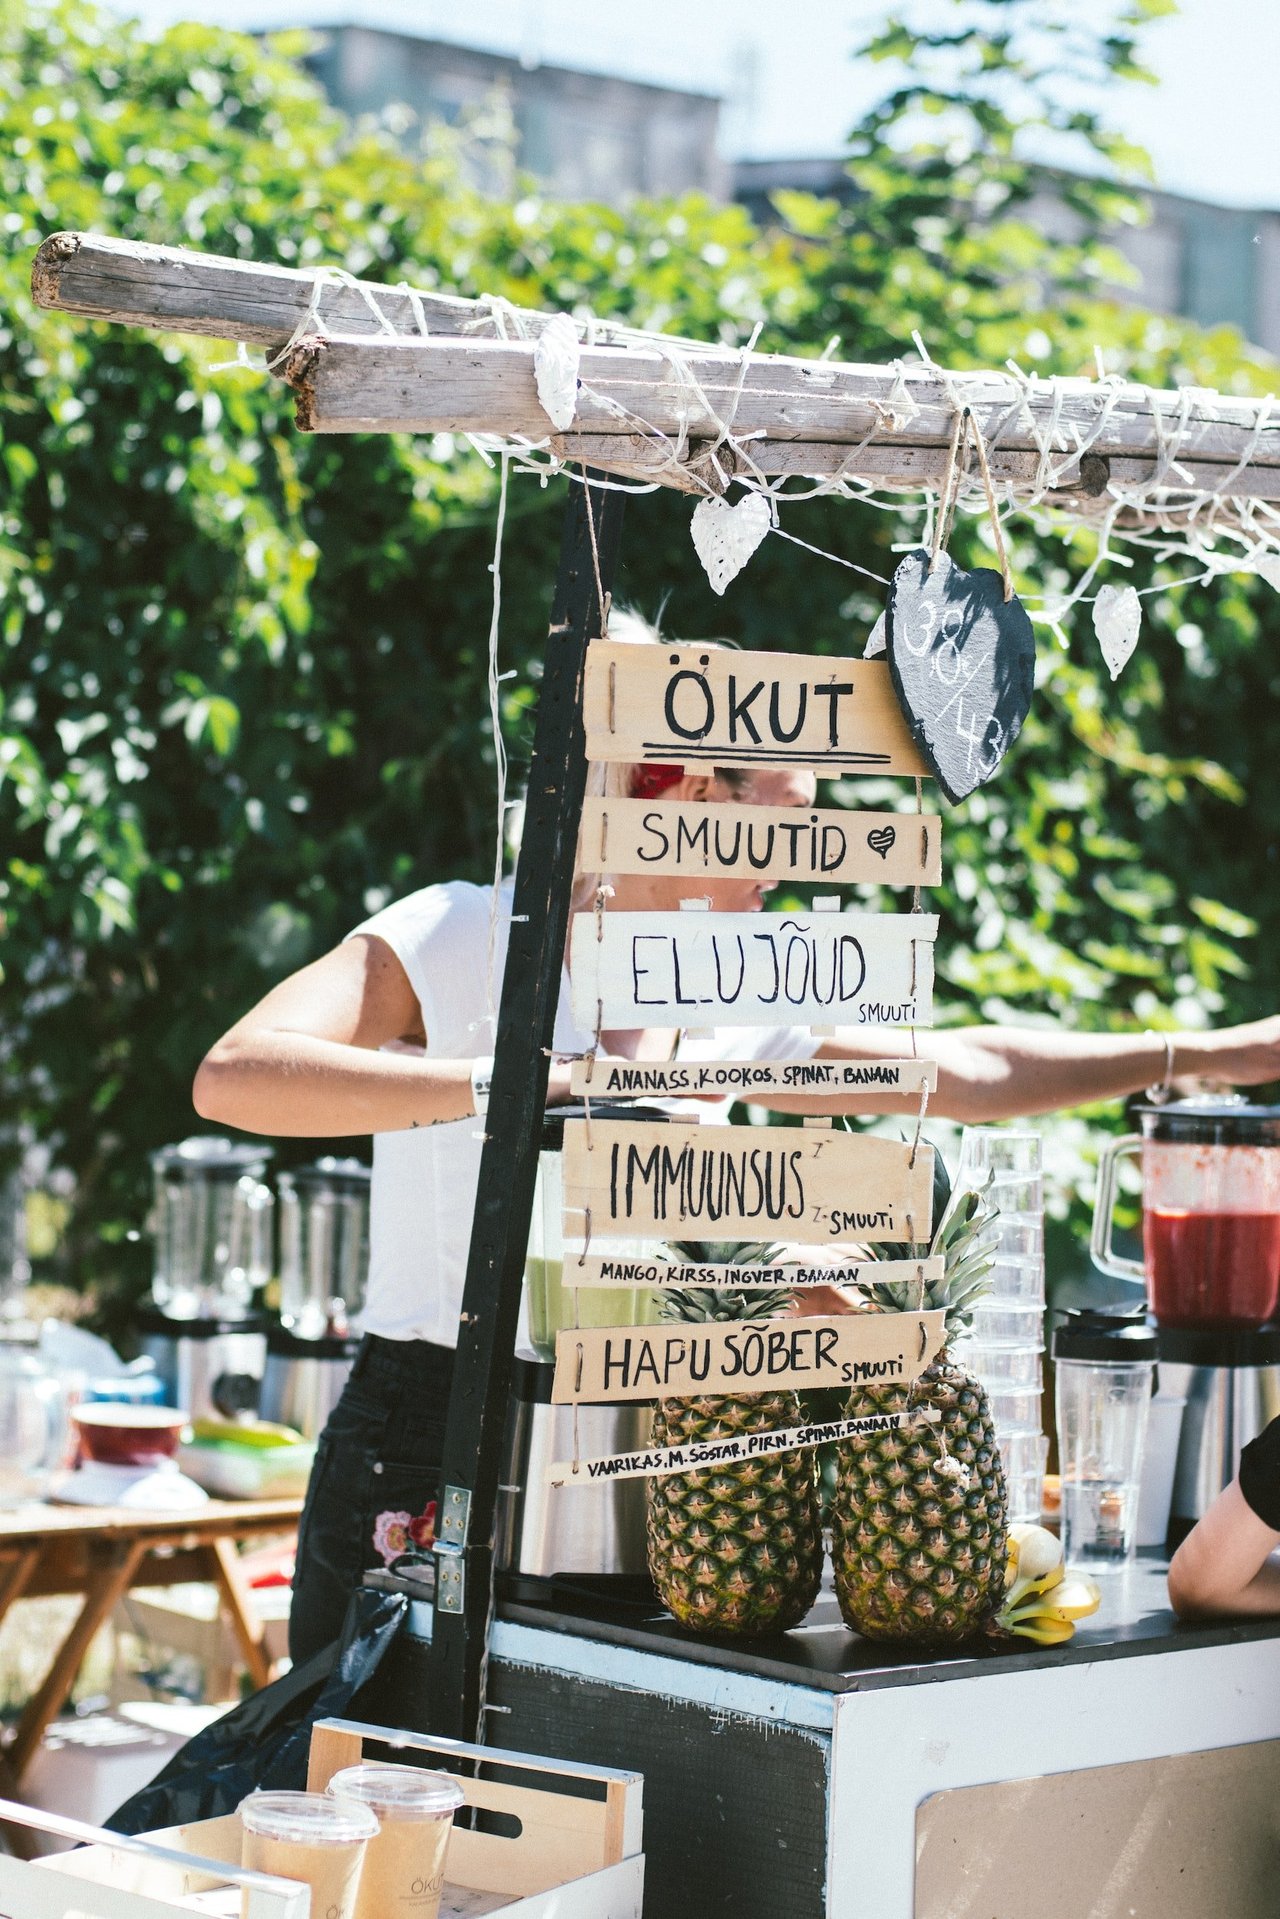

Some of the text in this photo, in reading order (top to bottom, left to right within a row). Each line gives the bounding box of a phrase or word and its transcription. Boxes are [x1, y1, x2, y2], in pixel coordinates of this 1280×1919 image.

[664, 654, 854, 747] ÖKUT
[633, 920, 866, 1005] ELUJÕUD
[843, 1066, 900, 1085] BANAAN
[610, 1141, 806, 1222] IMMUUNSUS
[796, 1267, 860, 1283] BANAAN
[603, 1324, 839, 1390] HAPU SÕBER
